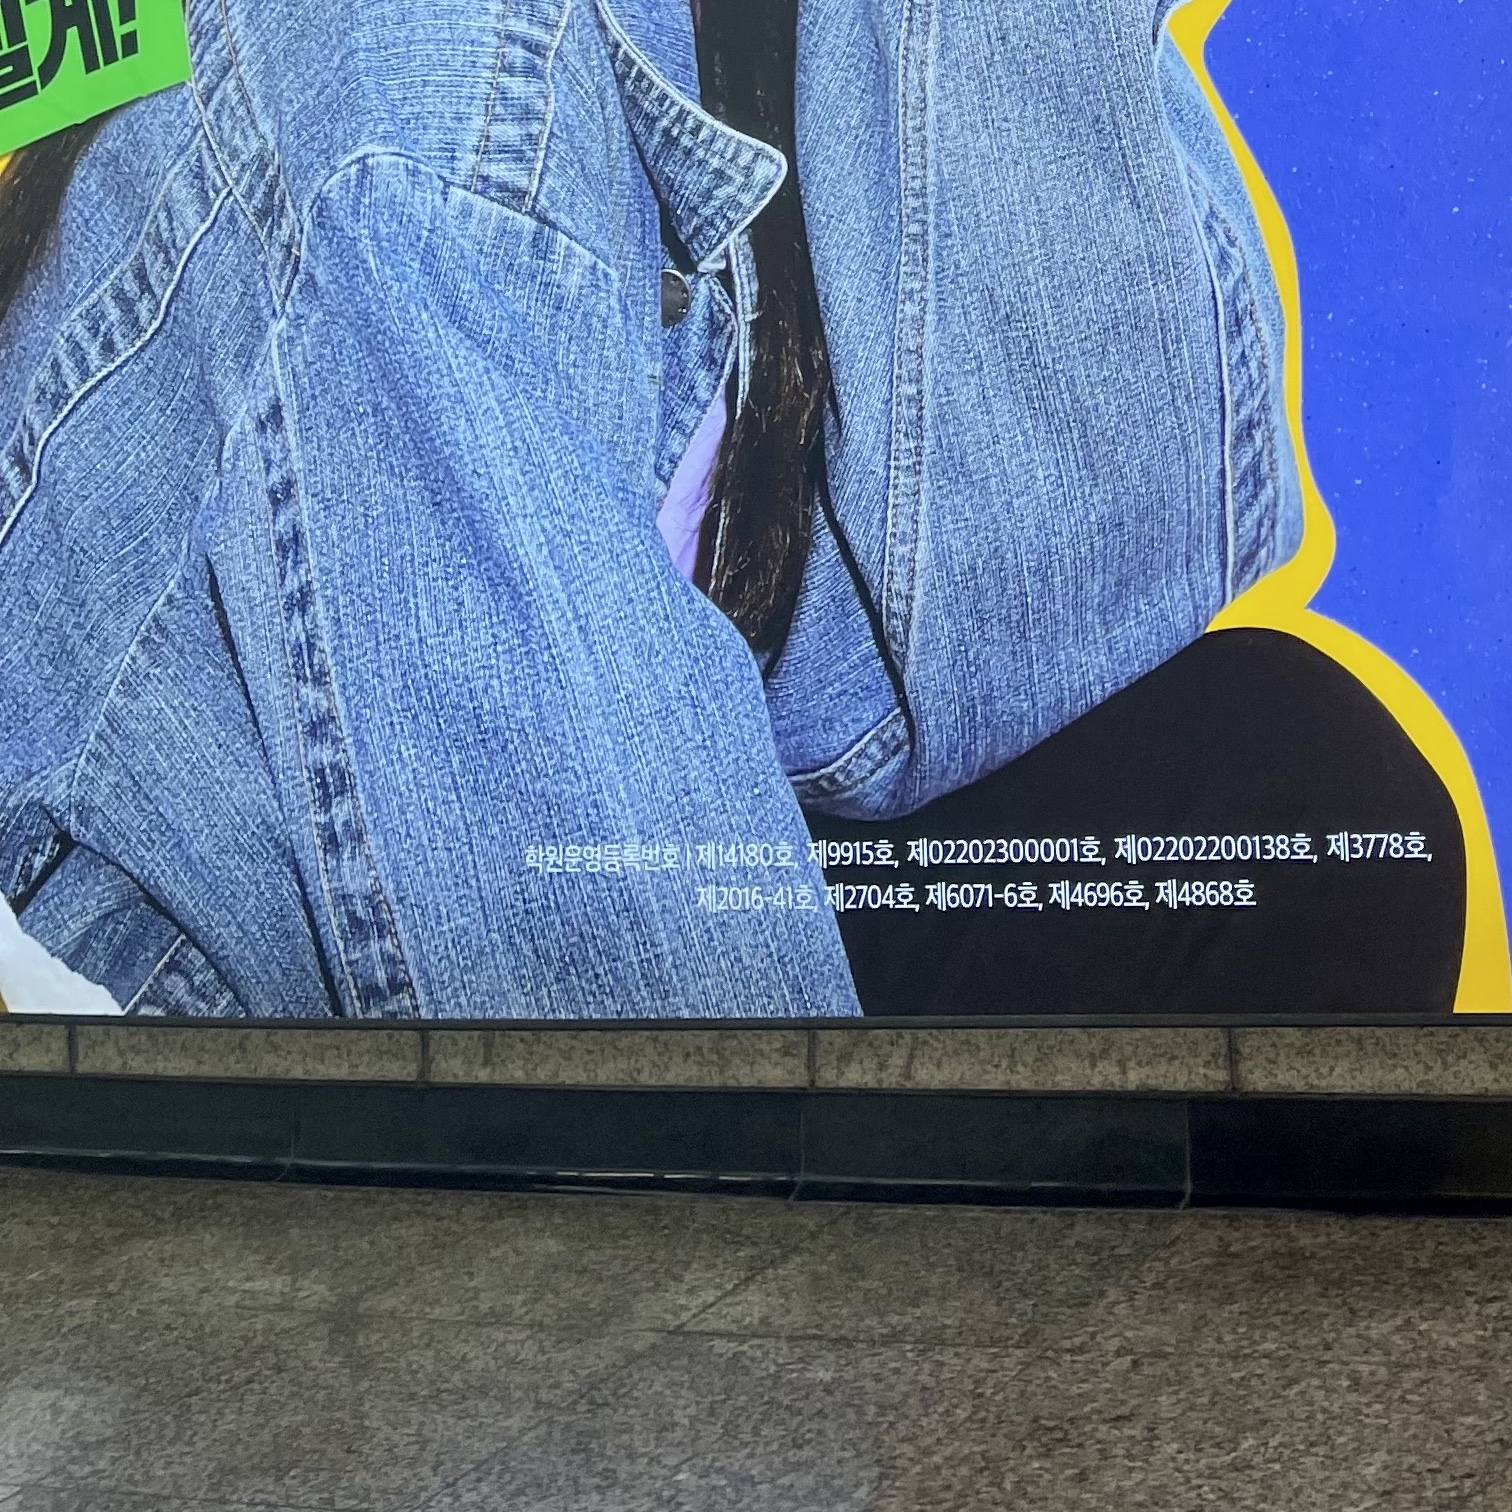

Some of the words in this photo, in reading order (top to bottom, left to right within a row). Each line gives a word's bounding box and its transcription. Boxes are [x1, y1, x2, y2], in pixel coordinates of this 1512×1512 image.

[525, 842, 682, 875] 학원운영등록번호
[695, 839, 799, 871] 제14180호,
[807, 838, 899, 870] 제9915호,
[907, 835, 1107, 868] 제02202300001호,
[1114, 833, 1318, 865] 제02202200138호,
[1326, 830, 1433, 863] 제3778호,
[695, 884, 819, 914] 제2016-41호,
[824, 882, 920, 913] 제2704호,
[925, 881, 1044, 912] 제6071-6호,
[1049, 879, 1150, 911] 제4696호,
[1155, 878, 1257, 910] 제4868호
